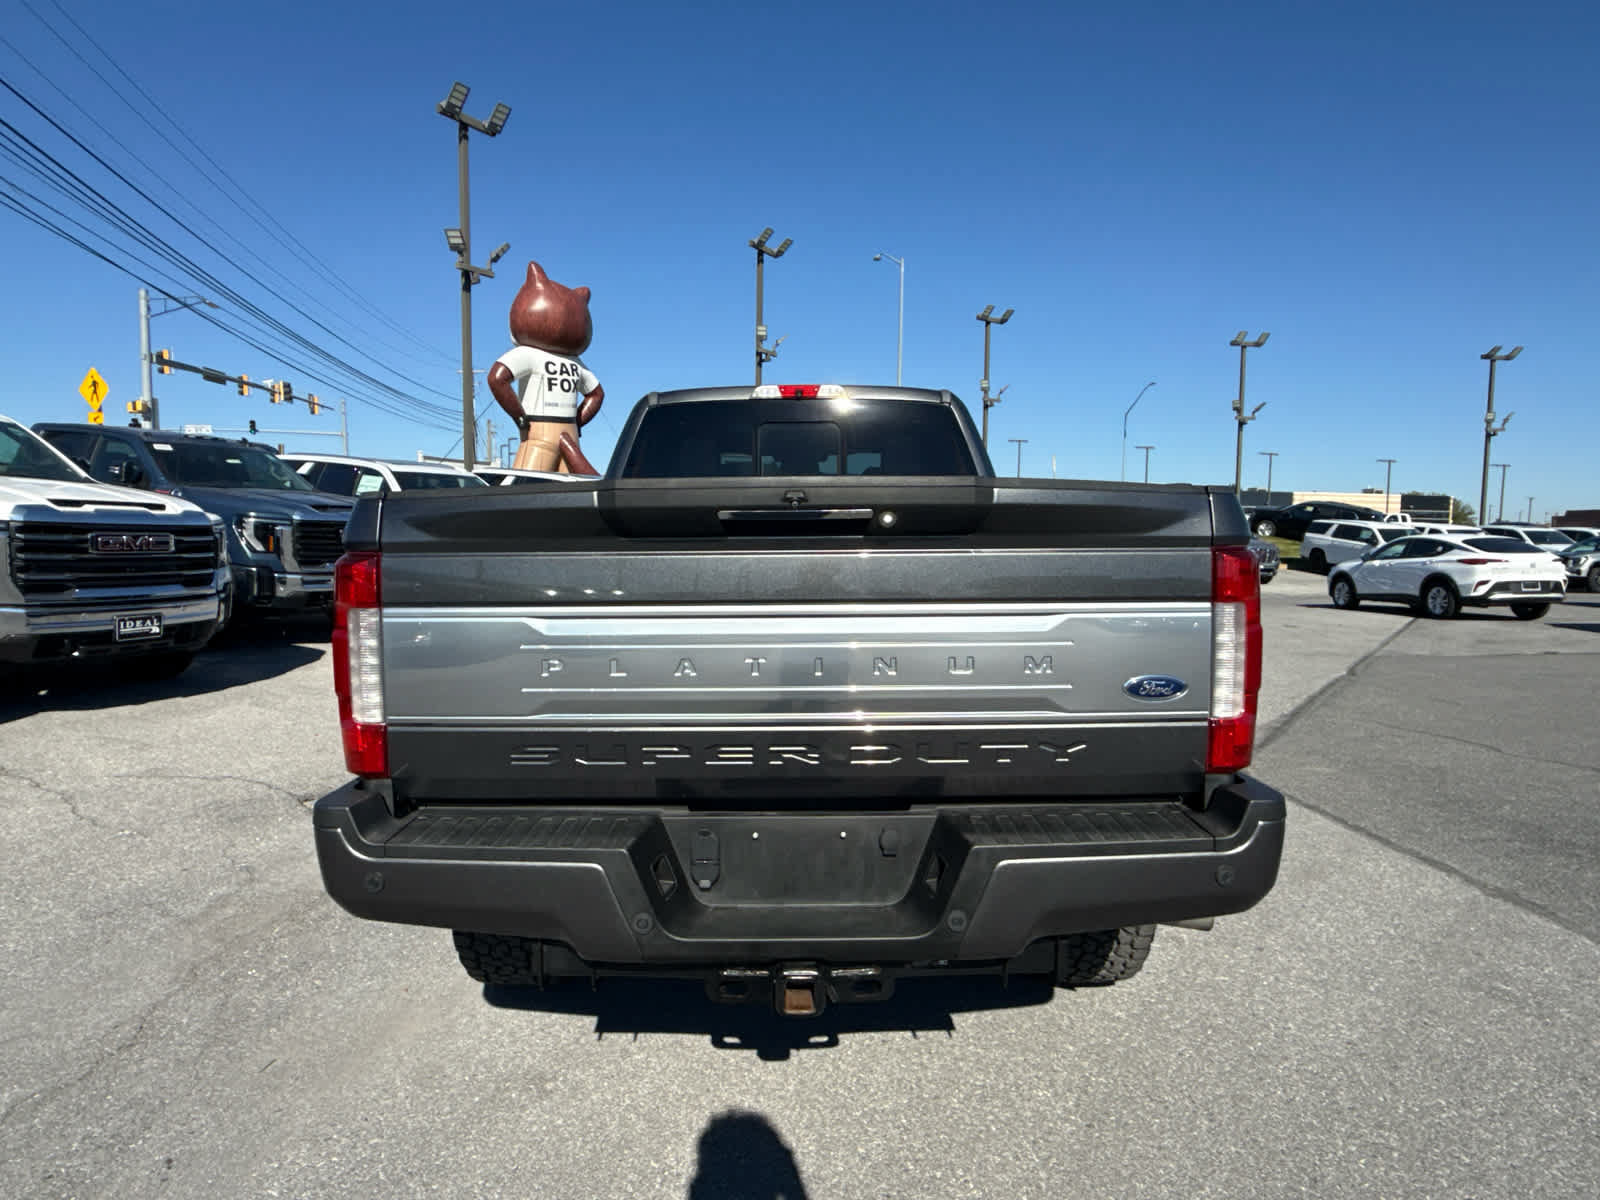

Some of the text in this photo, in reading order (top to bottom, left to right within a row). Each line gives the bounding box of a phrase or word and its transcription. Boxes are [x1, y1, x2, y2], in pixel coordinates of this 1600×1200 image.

[545, 361, 579, 377] CAR
[547, 377, 579, 393] FOX
[97, 535, 170, 552] GMC
[120, 618, 160, 629] IDEAL
[540, 655, 1053, 678] PLATINUM
[1139, 680, 1176, 696] Ford
[509, 743, 1088, 766] SUPER DUTY
